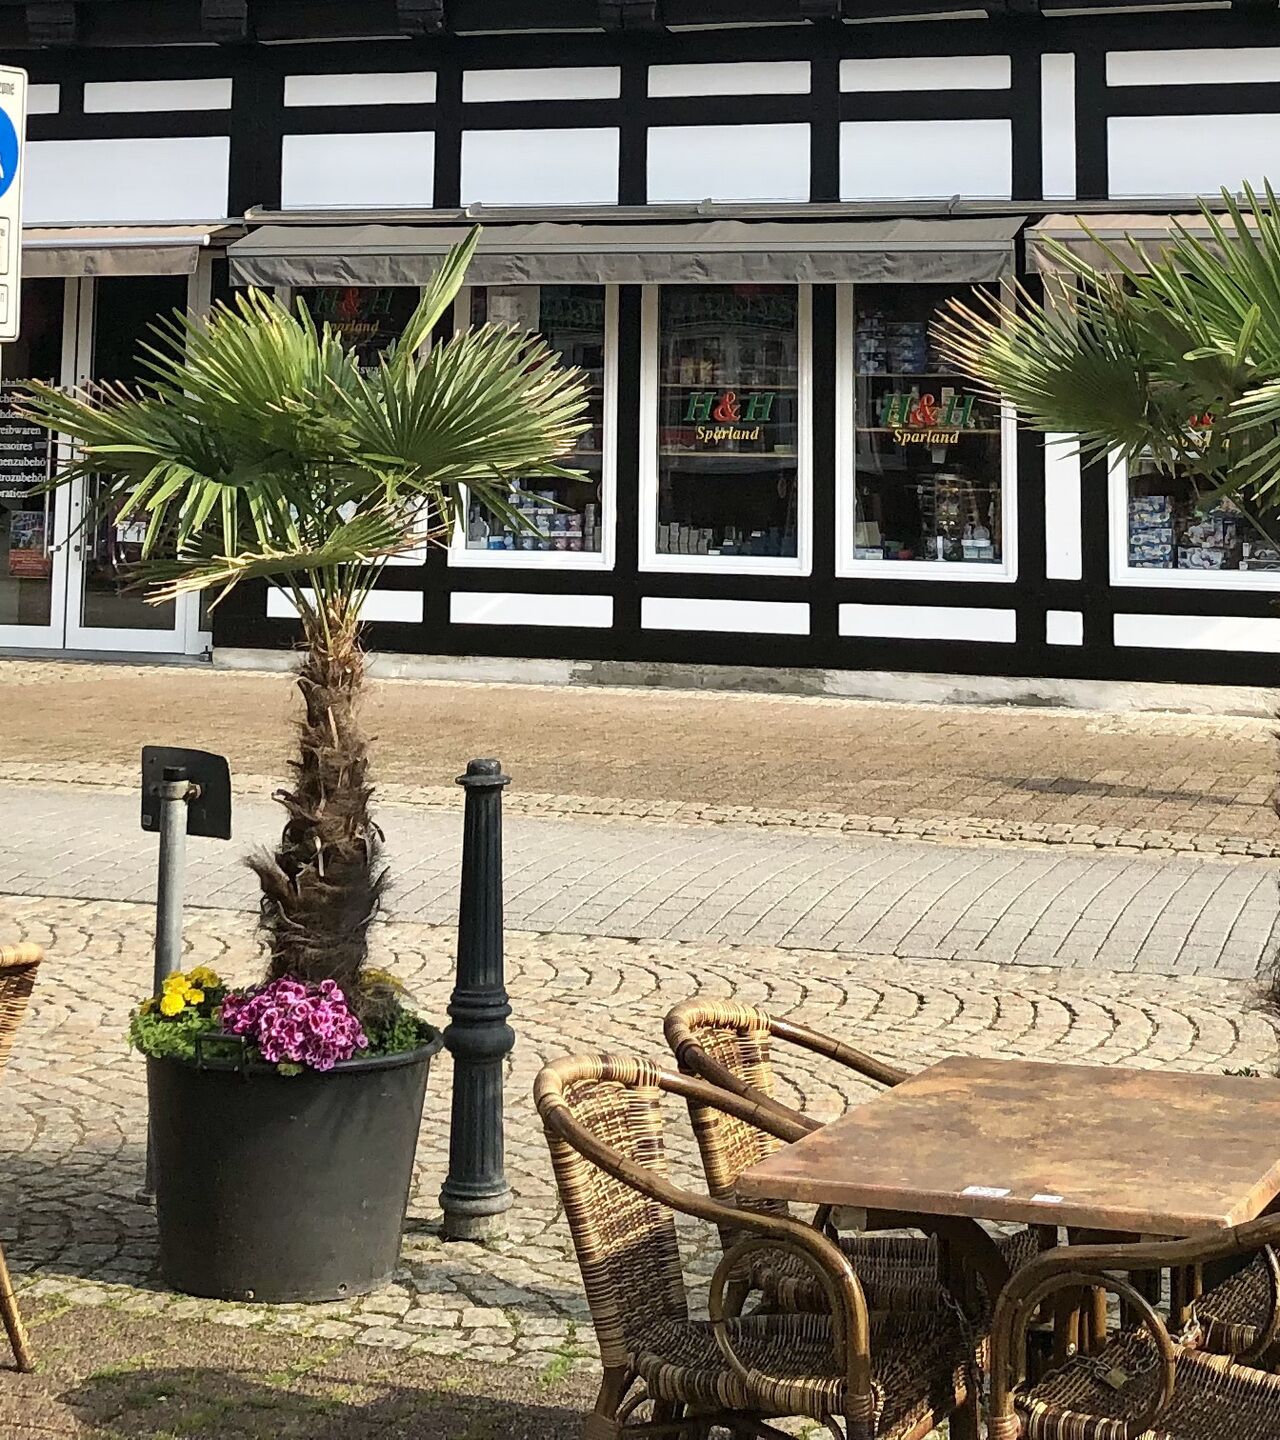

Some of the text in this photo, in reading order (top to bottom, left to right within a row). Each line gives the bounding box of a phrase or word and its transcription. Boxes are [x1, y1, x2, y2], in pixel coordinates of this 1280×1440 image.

[326, 319, 380, 335] parland
[696, 426, 760, 444] Sparland
[893, 429, 960, 447] Sparland
